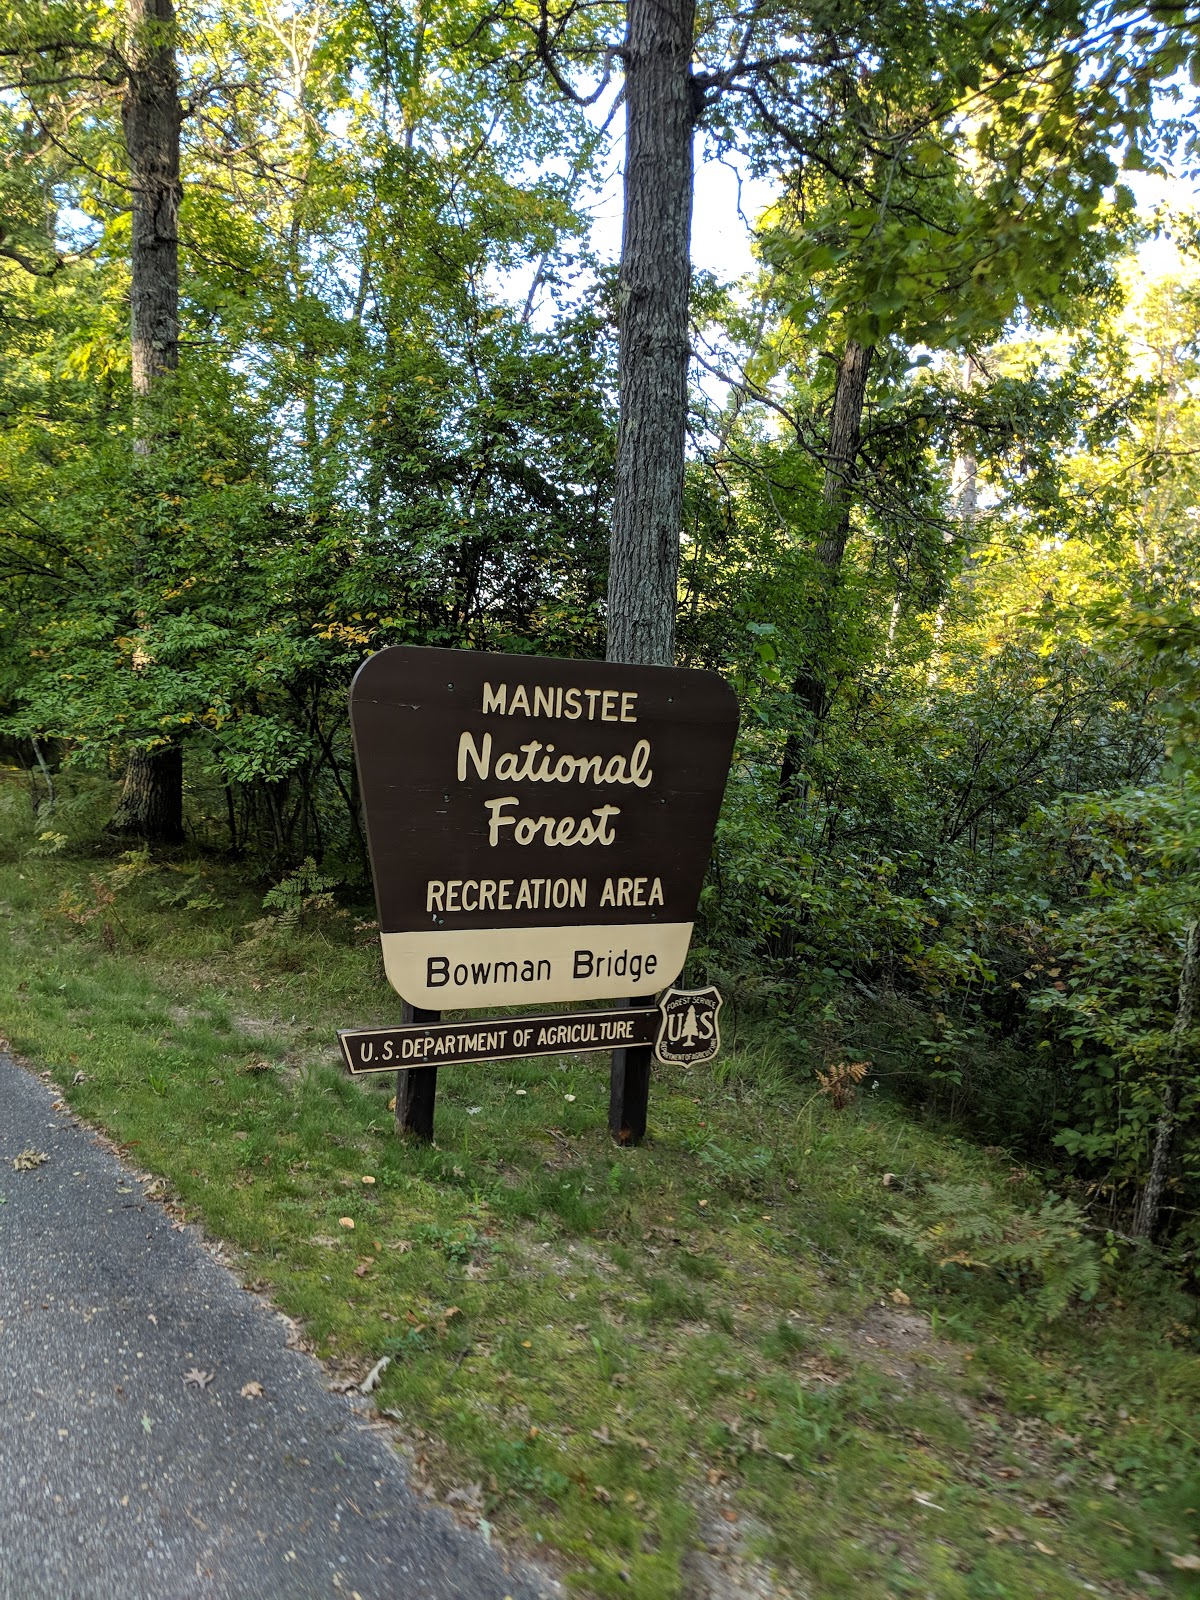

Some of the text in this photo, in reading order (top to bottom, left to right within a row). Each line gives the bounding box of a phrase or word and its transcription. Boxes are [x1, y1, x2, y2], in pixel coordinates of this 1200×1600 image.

[482, 681, 639, 723] MANISTEE
[457, 731, 653, 788] National
[484, 796, 621, 847] Forest
[426, 877, 665, 912] RECREATION AREA
[426, 949, 658, 988] Bowman Bridge
[667, 997, 716, 1011] FOREST SERVICE
[512, 1028, 534, 1048] OF
[537, 1020, 635, 1046] AGRICULTURE
